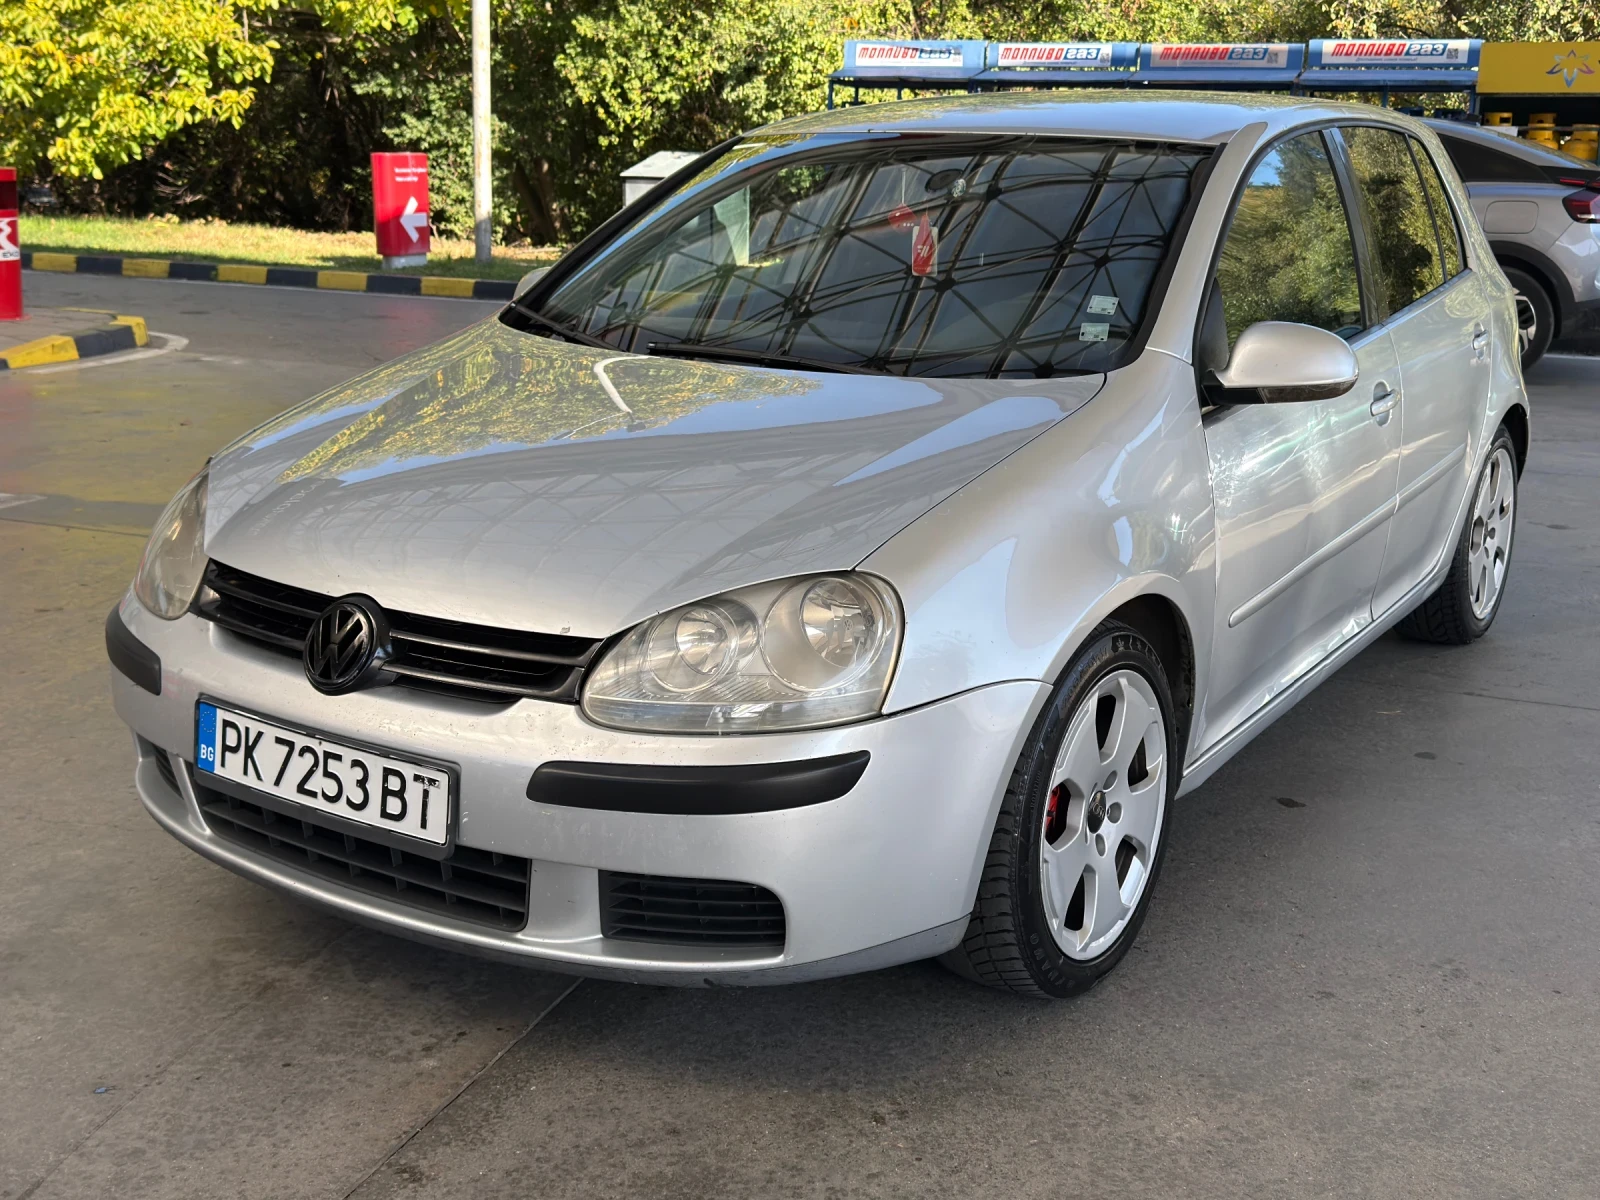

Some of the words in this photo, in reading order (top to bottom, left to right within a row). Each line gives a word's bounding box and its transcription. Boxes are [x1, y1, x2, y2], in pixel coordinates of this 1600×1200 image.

[200, 744, 214, 762] BG
[220, 718, 264, 782] PK
[273, 735, 370, 812] 7253
[380, 766, 440, 830] BT
